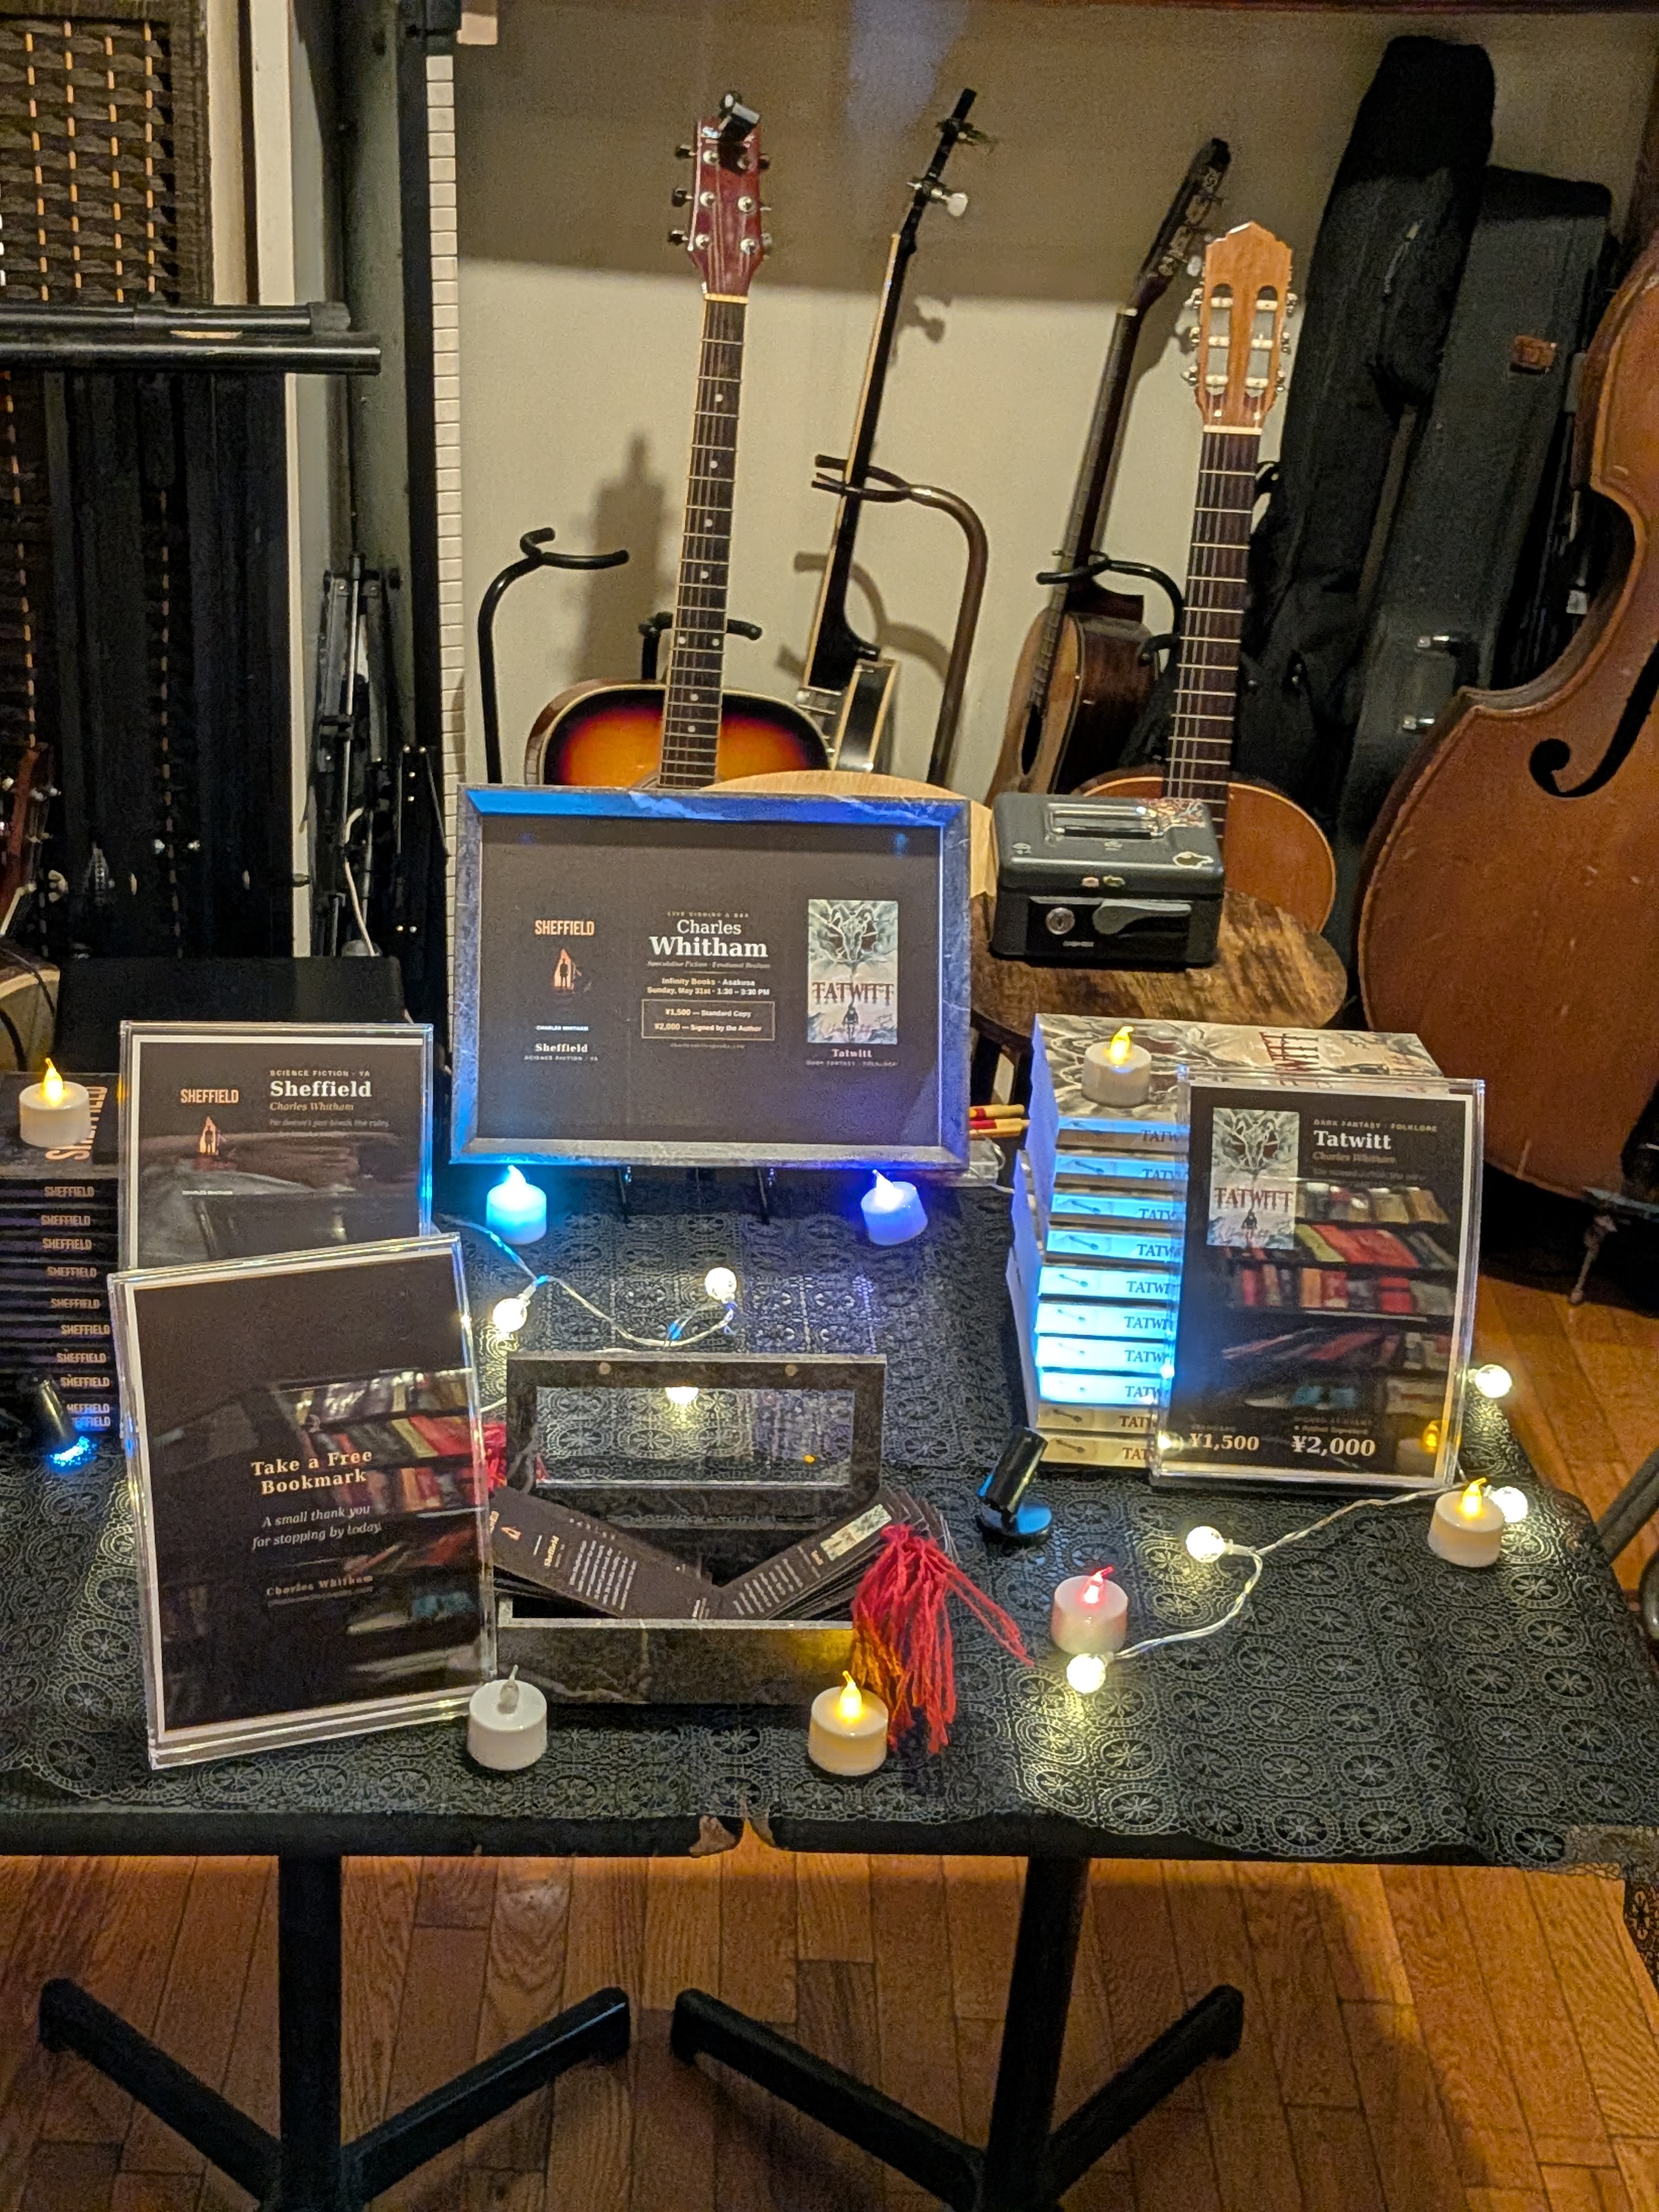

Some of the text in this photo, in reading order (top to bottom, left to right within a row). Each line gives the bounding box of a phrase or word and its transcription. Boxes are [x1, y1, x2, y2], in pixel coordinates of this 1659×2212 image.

[534, 920, 595, 936] SHEFFIELD
[676, 919, 742, 935] Charles
[649, 936, 768, 957] Whitham
[811, 982, 895, 1000] TATWITT
[534, 1043, 588, 1053] Sheffield
[831, 1048, 873, 1058] Tatwitt
[180, 1089, 239, 1103] SHEFFIELD
[269, 1080, 372, 1098] Sheffield
[269, 1102, 307, 1111] Charles
[1313, 1130, 1392, 1150] Tatwitt
[44, 1186, 95, 1198] SHEFFIELD
[1214, 1187, 1294, 1213] TATWITT
[41, 1215, 91, 1226] SHEFFIELD
[42, 1238, 92, 1250] SHEFFIELD
[50, 1298, 101, 1310] SHEFFIELD
[61, 1324, 110, 1335] SHEFFIELD
[57, 1353, 107, 1364] SHEFFIELD
[60, 1376, 110, 1387] SHEFFIELD
[1190, 1433, 1376, 1457] ¥1,500 ¥2,000
[251, 1451, 373, 1477] Take a Free
[261, 1468, 367, 1496] Bookmark
[261, 1505, 371, 1528] A small thank you
[252, 1537, 272, 1552] for
[273, 1528, 326, 1546] stopping
[330, 1526, 345, 1540] by
